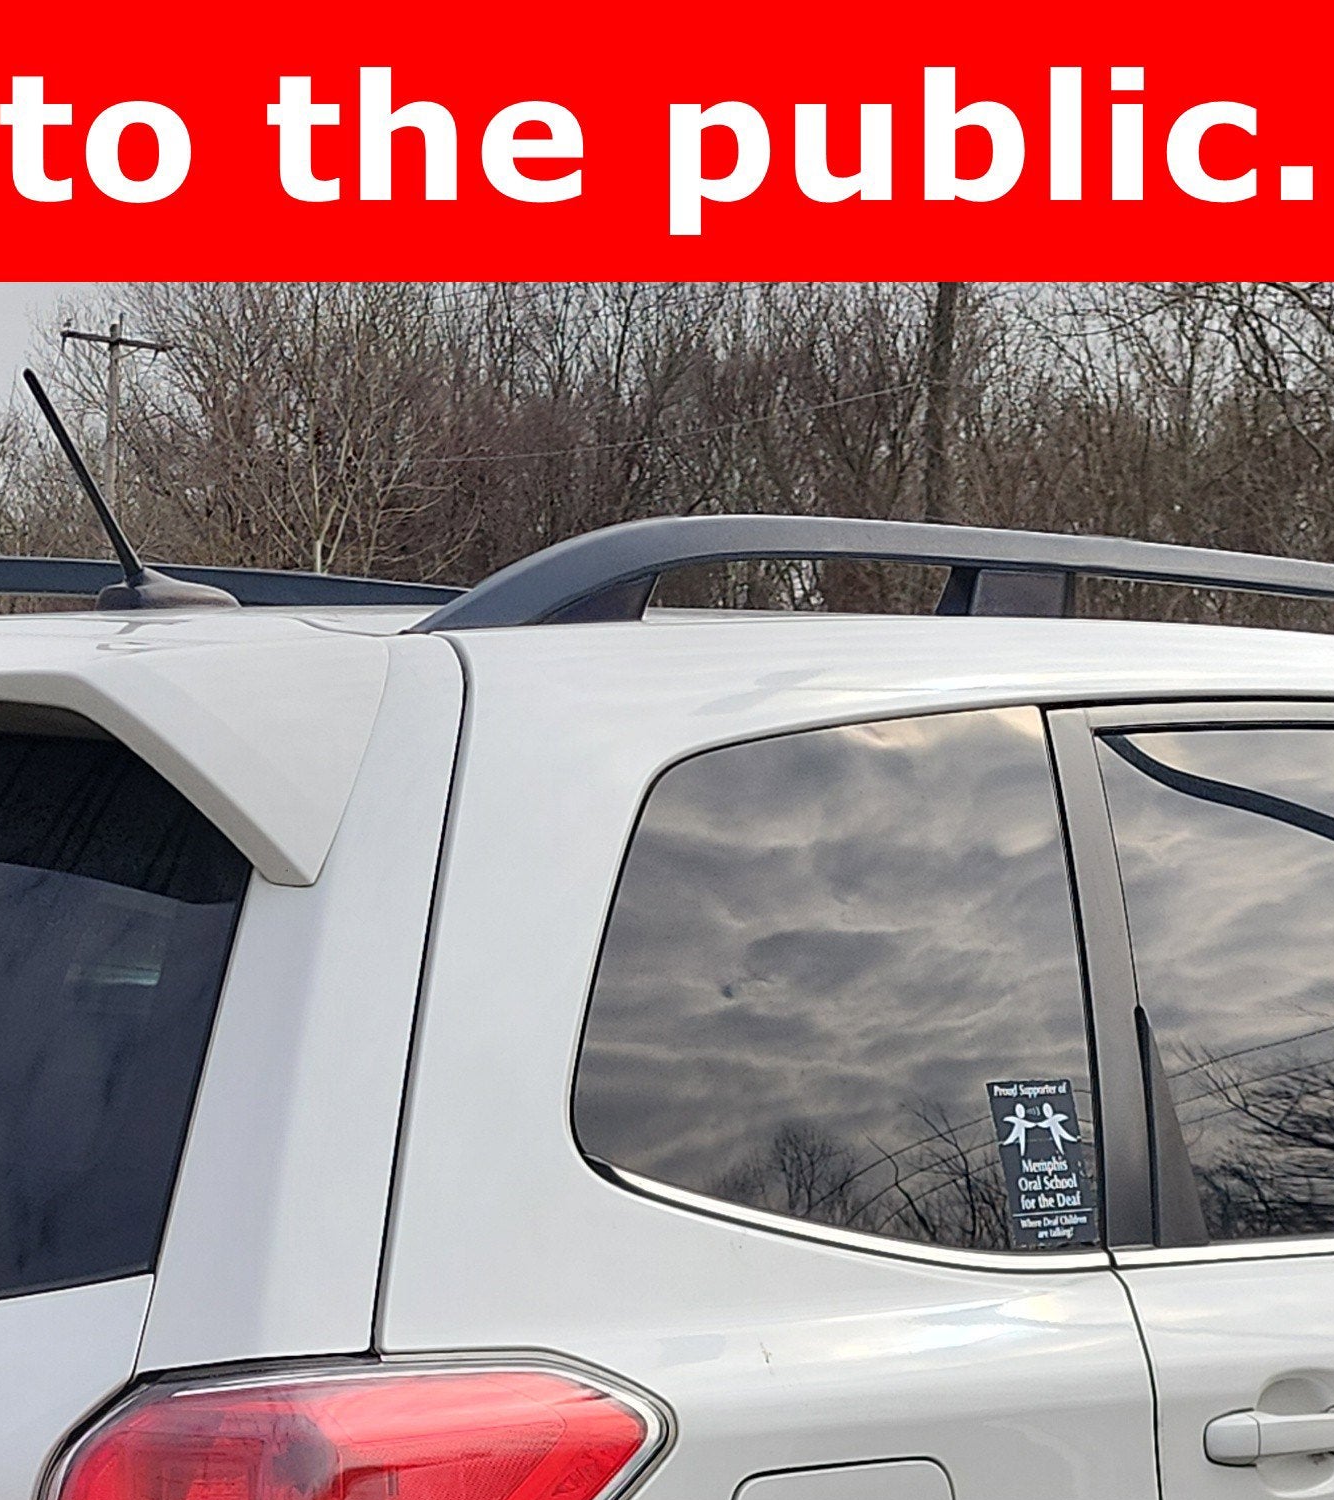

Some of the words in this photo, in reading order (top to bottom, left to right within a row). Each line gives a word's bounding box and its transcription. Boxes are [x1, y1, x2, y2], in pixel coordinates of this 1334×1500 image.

[993, 1084, 1018, 1097] Proud
[1018, 1083, 1056, 1098] Supporter
[1058, 1082, 1067, 1094] of
[1021, 1156, 1068, 1176] Memphis
[1018, 1177, 1042, 1192] Oral
[1044, 1175, 1078, 1191] School
[1020, 1195, 1037, 1210] for
[1038, 1194, 1055, 1209] the
[1056, 1190, 1082, 1208] Deaf
[1020, 1218, 1042, 1229] Where
[1059, 1215, 1088, 1226] Children
[1038, 1229, 1048, 1239] are
